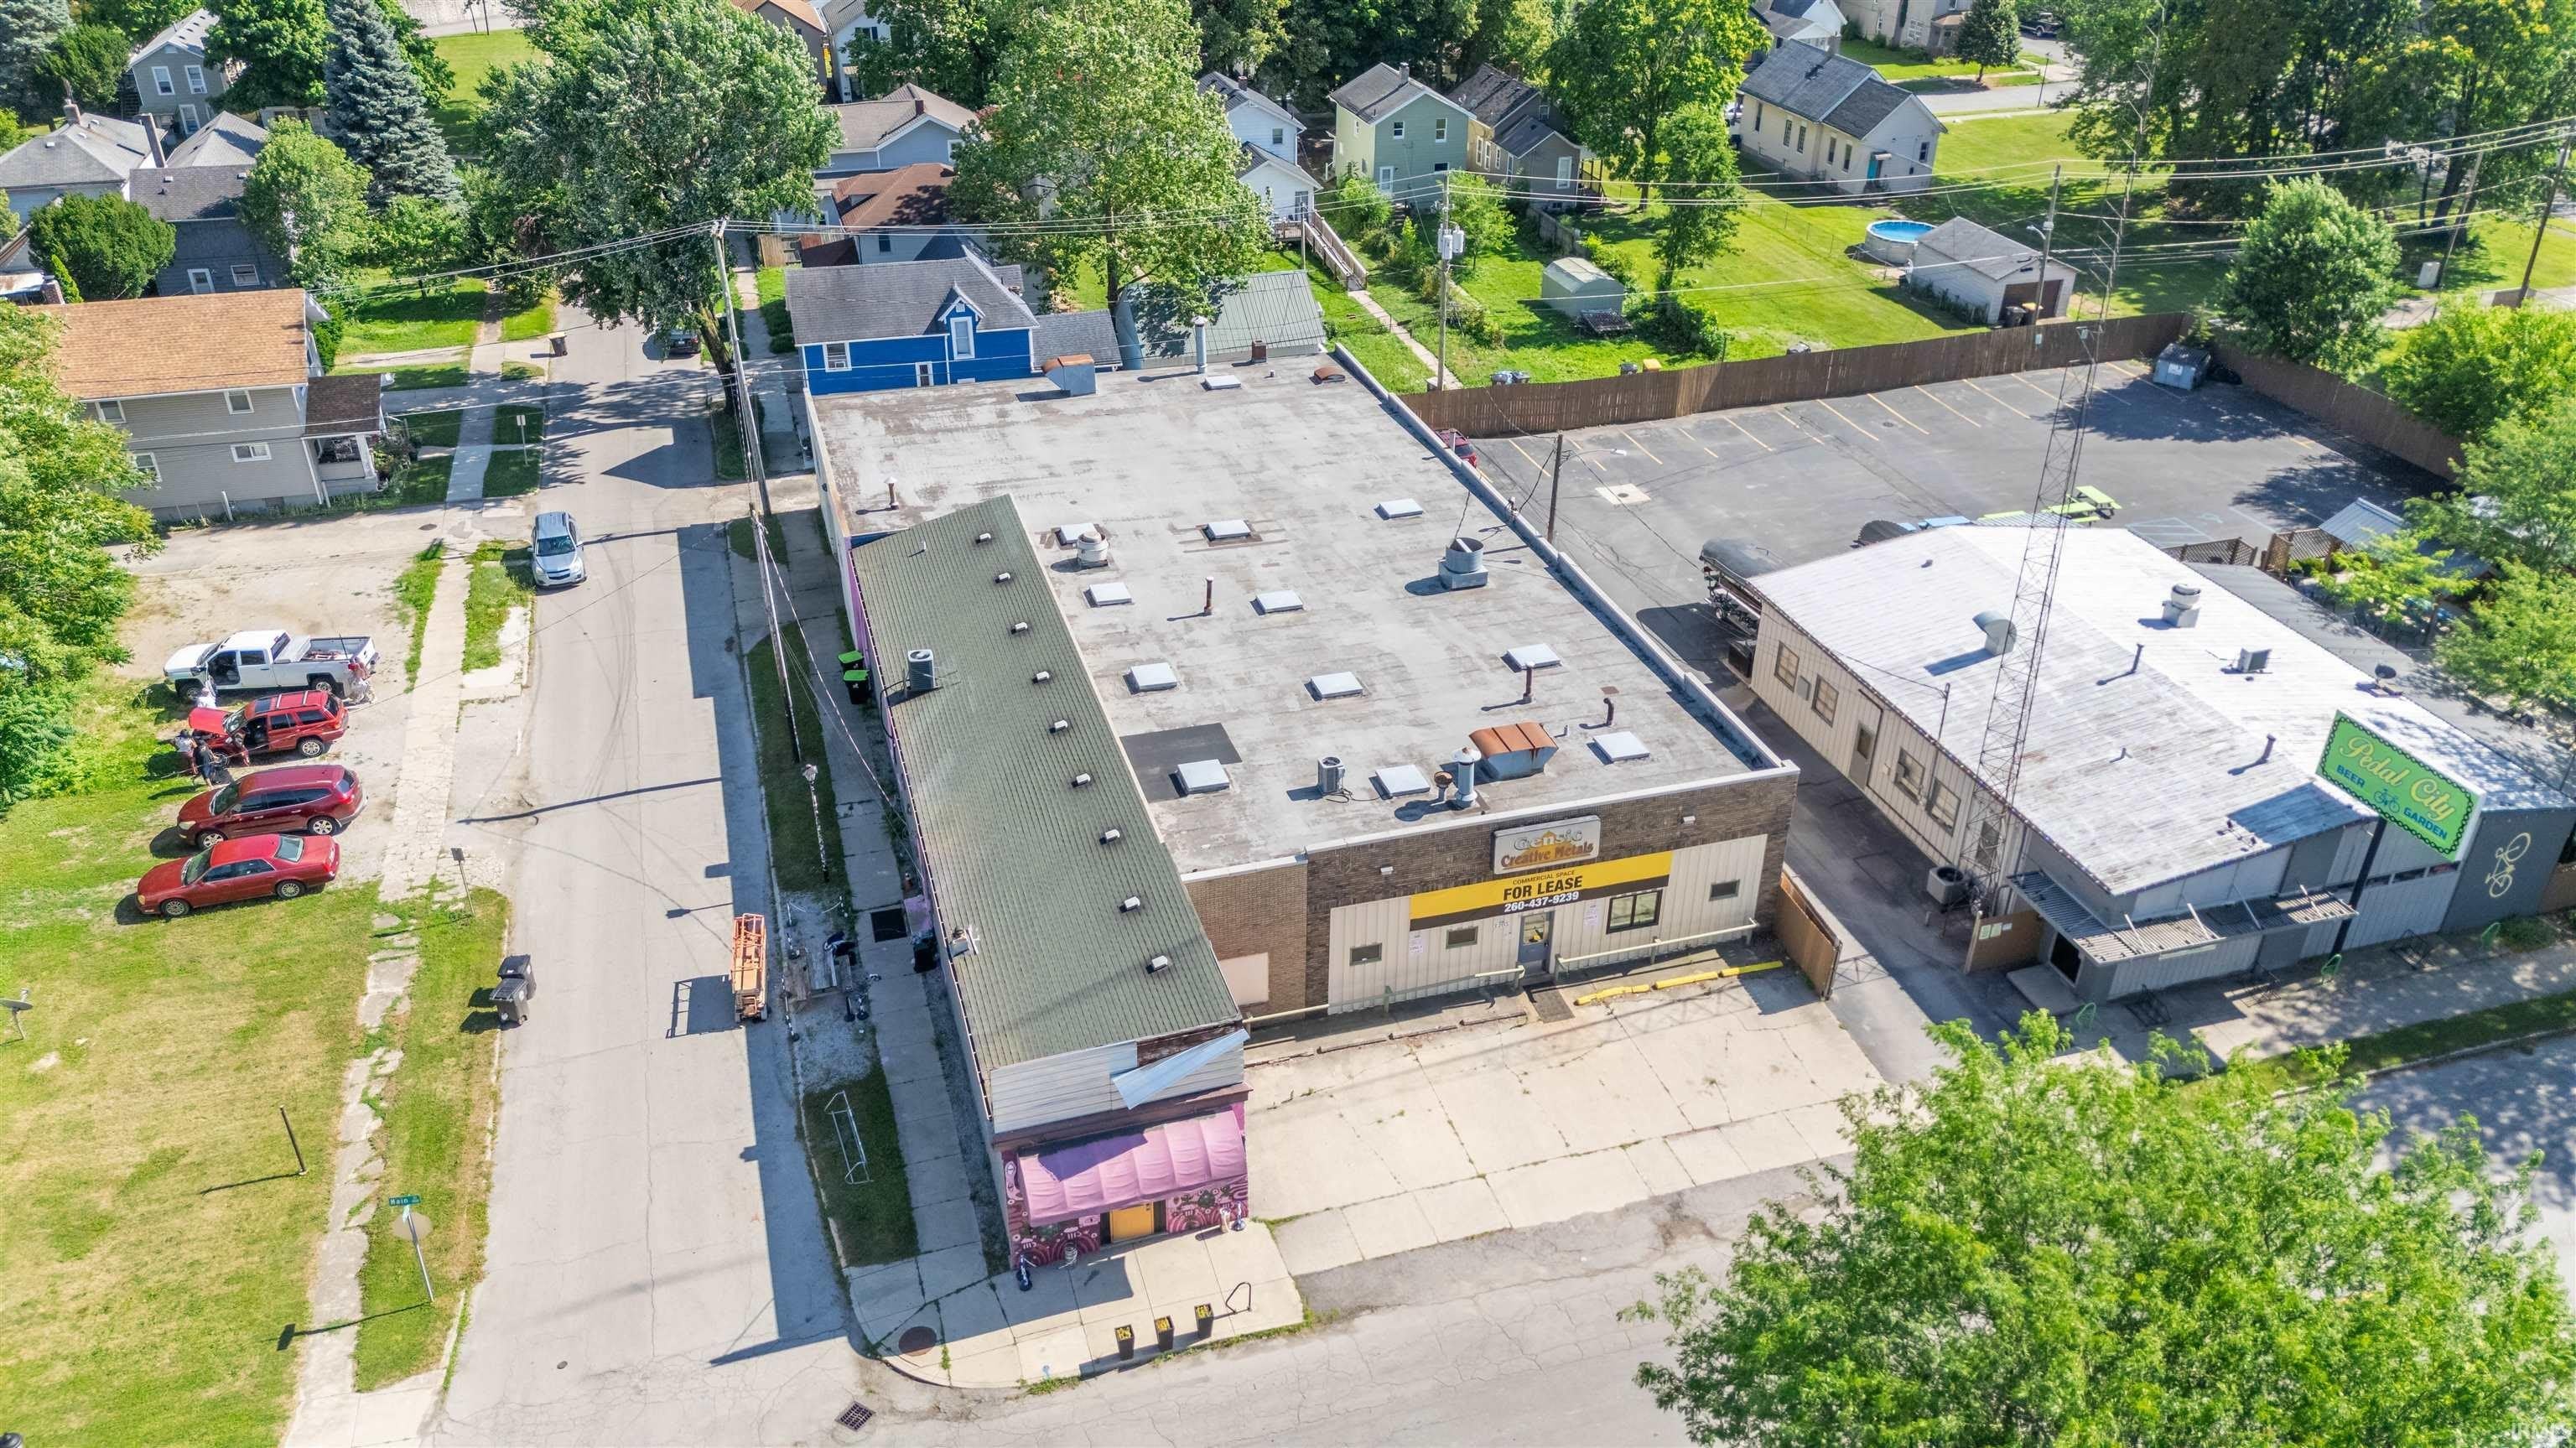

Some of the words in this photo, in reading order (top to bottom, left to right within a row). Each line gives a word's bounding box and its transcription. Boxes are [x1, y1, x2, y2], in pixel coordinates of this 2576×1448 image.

[2339, 736, 2410, 786] Pedal
[2410, 778, 2455, 822] City
[2336, 765, 2366, 788] BEER
[2403, 807, 2448, 840] GARDEN
[1501, 850, 1551, 868] Creative
[1555, 841, 1594, 857] Metals
[1504, 885, 1532, 900] FOR
[1537, 875, 1583, 895] LEASE
[1513, 874, 1554, 885] COMMERCIAL
[1556, 870, 1575, 879] SPACE
[1504, 891, 1580, 913] 260-437-9239
